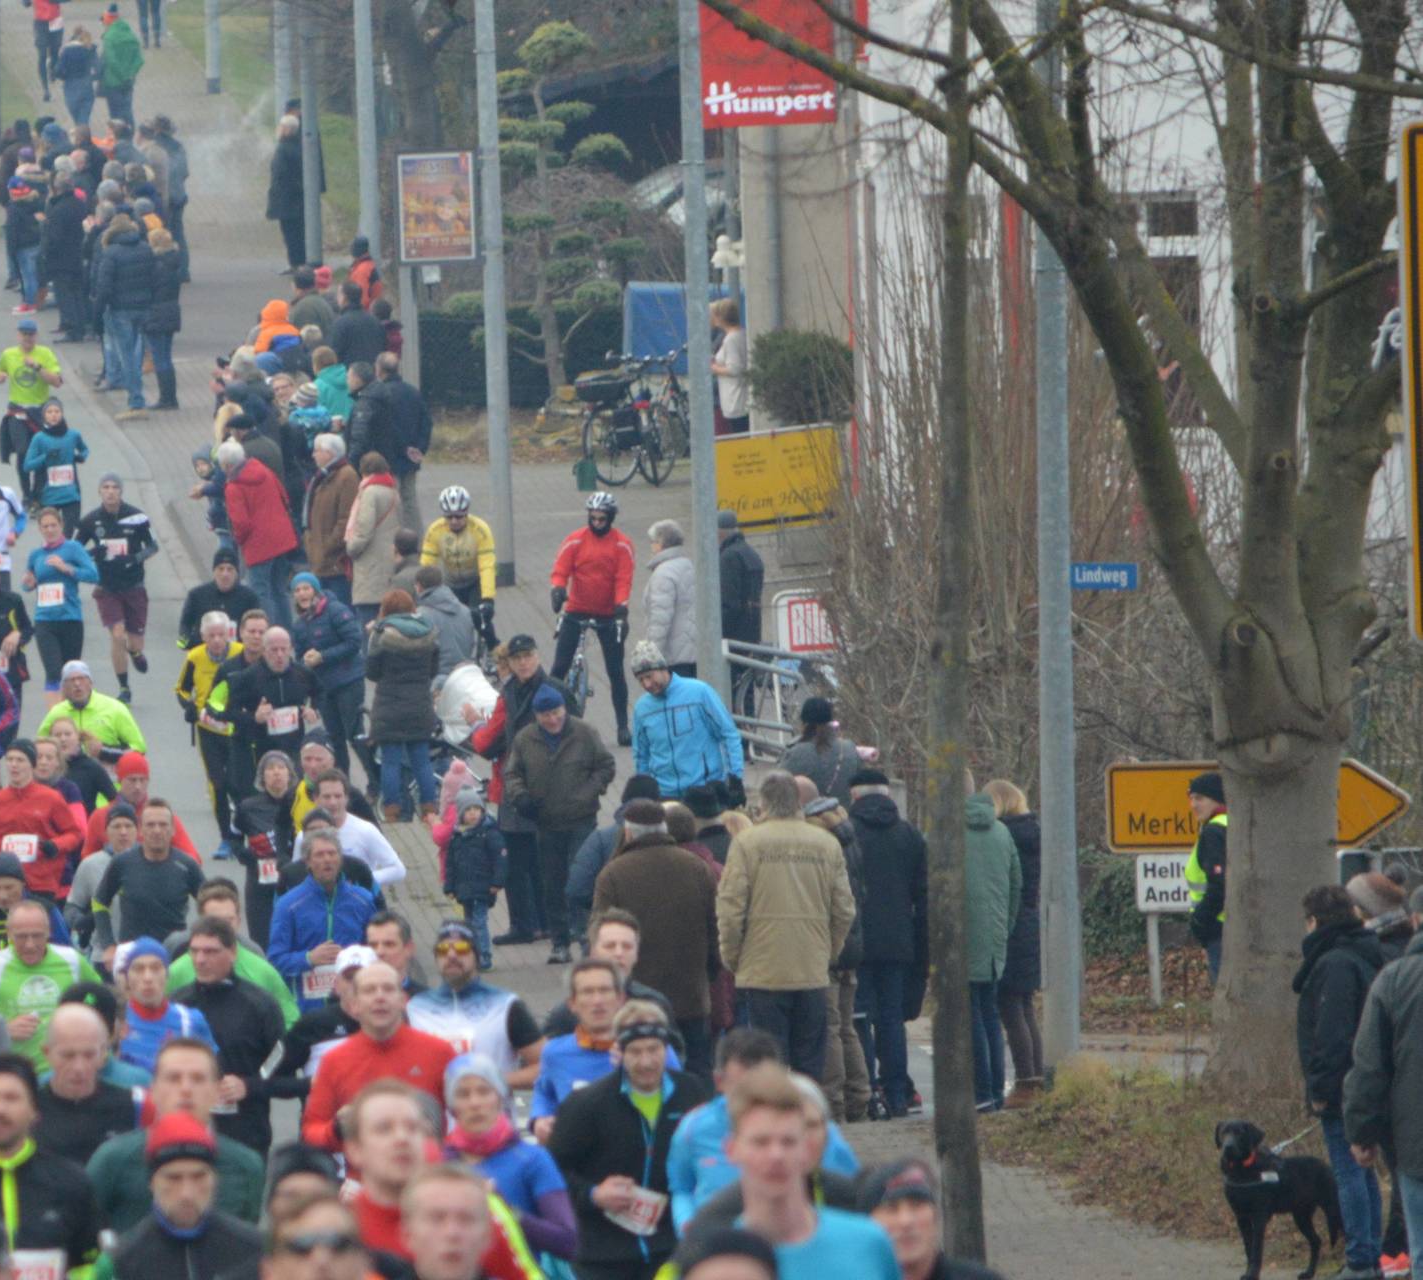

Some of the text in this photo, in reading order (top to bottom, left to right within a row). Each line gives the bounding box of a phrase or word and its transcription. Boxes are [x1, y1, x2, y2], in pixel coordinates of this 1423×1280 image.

[704, 80, 835, 117] Humpert
[1074, 566, 1129, 588] Lindweg
[1128, 811, 1200, 835] Merkl
